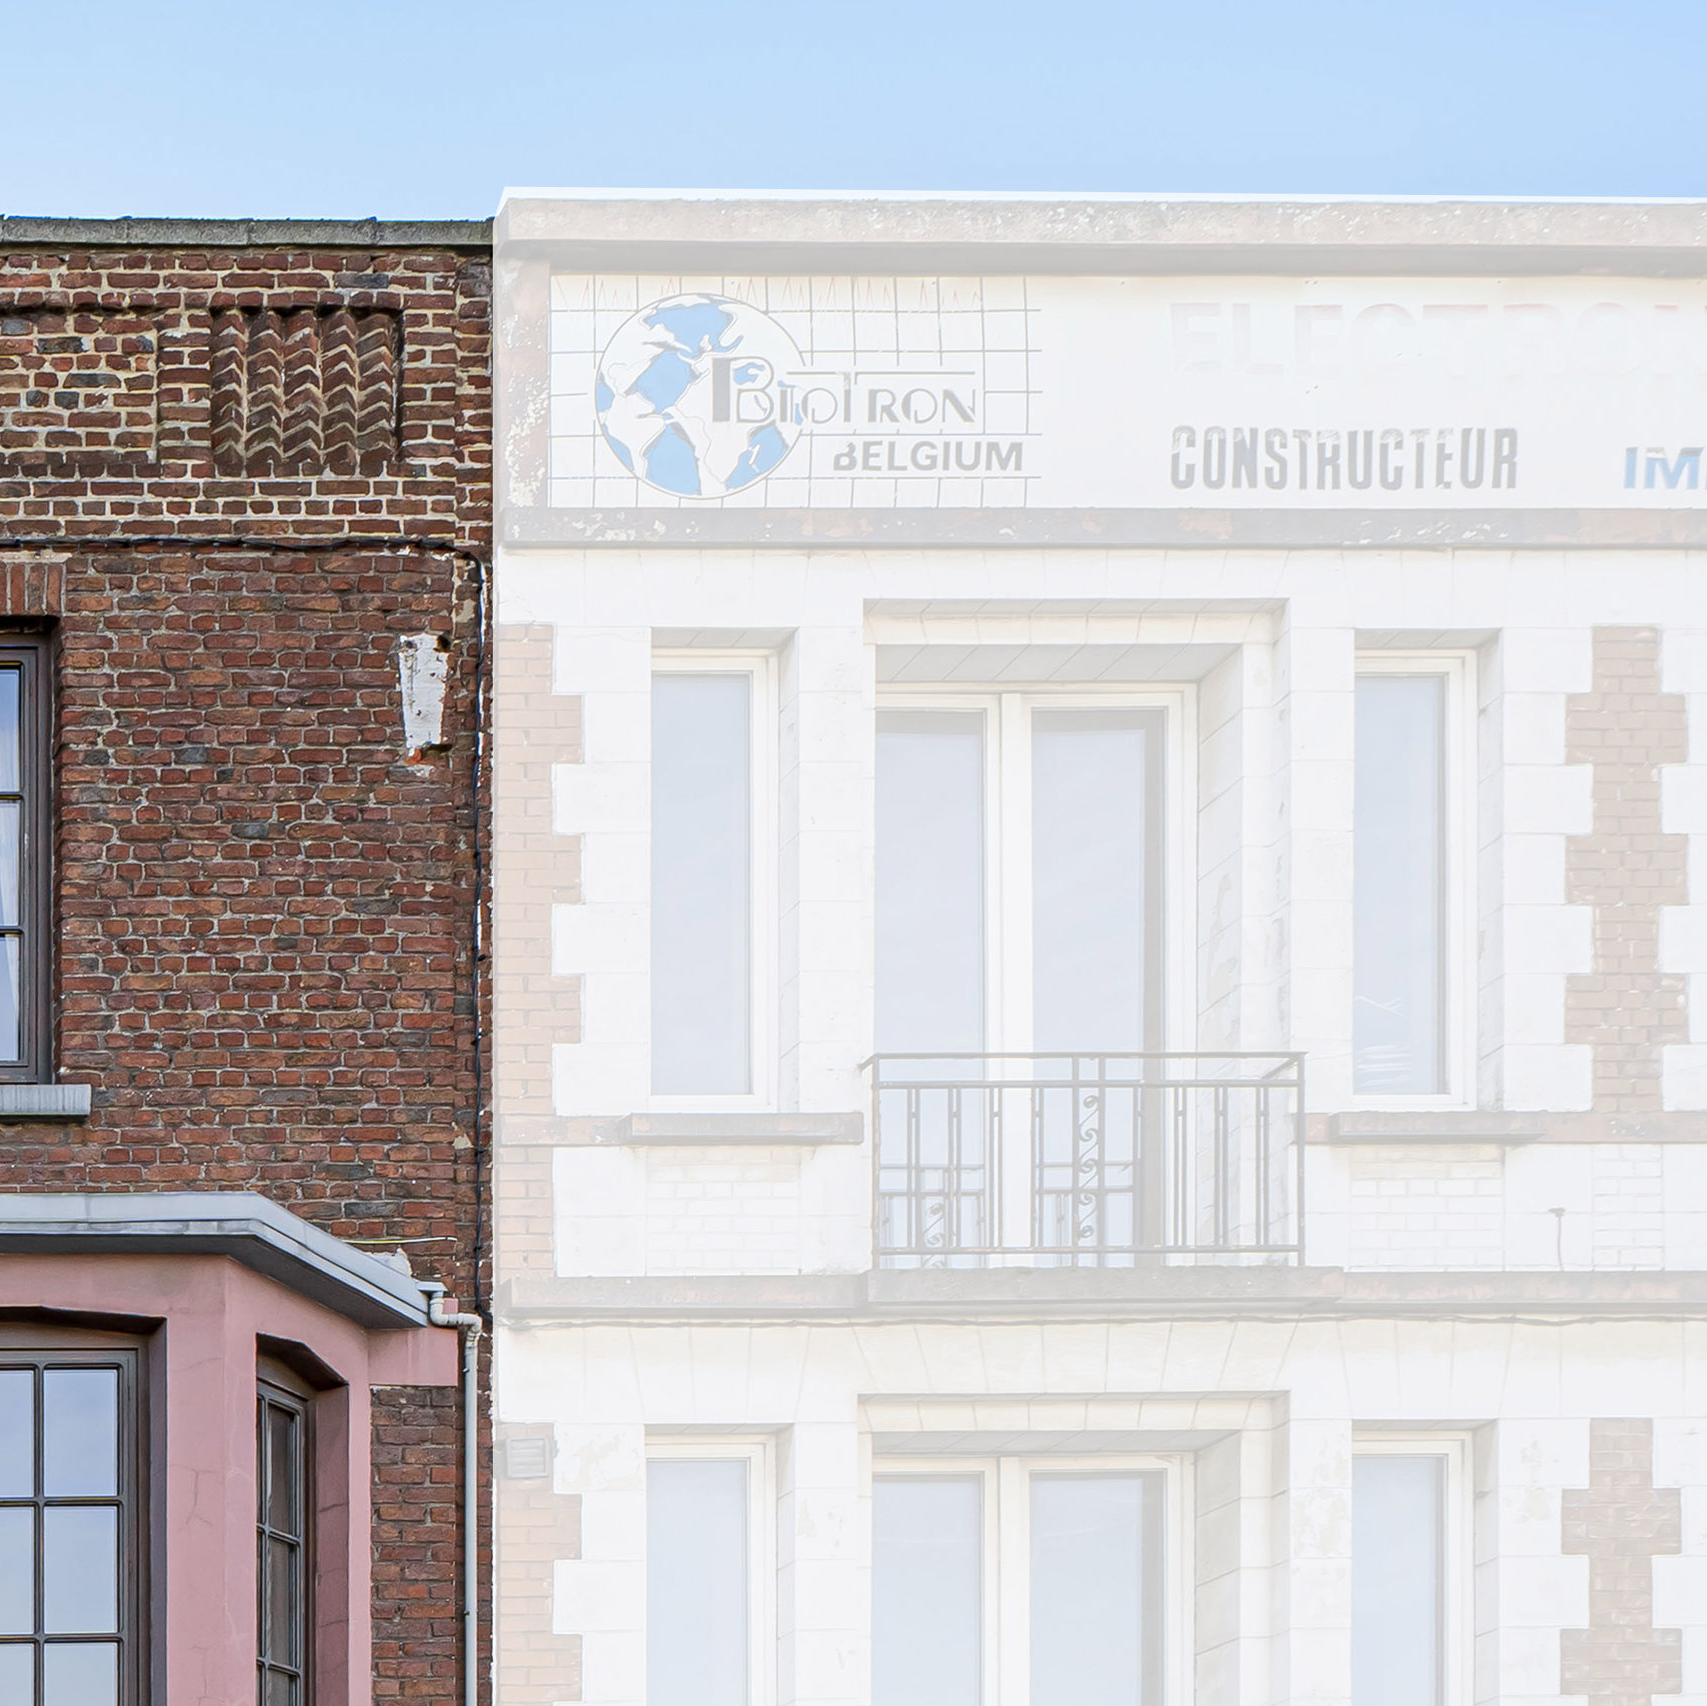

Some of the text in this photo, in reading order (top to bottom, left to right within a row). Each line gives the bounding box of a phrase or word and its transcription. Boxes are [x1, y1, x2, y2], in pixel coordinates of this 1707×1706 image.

[833, 440, 1024, 472] BELGIUM
[1170, 424, 1518, 491] CONSTRUCTEUR
[1624, 446, 1707, 490] IM
